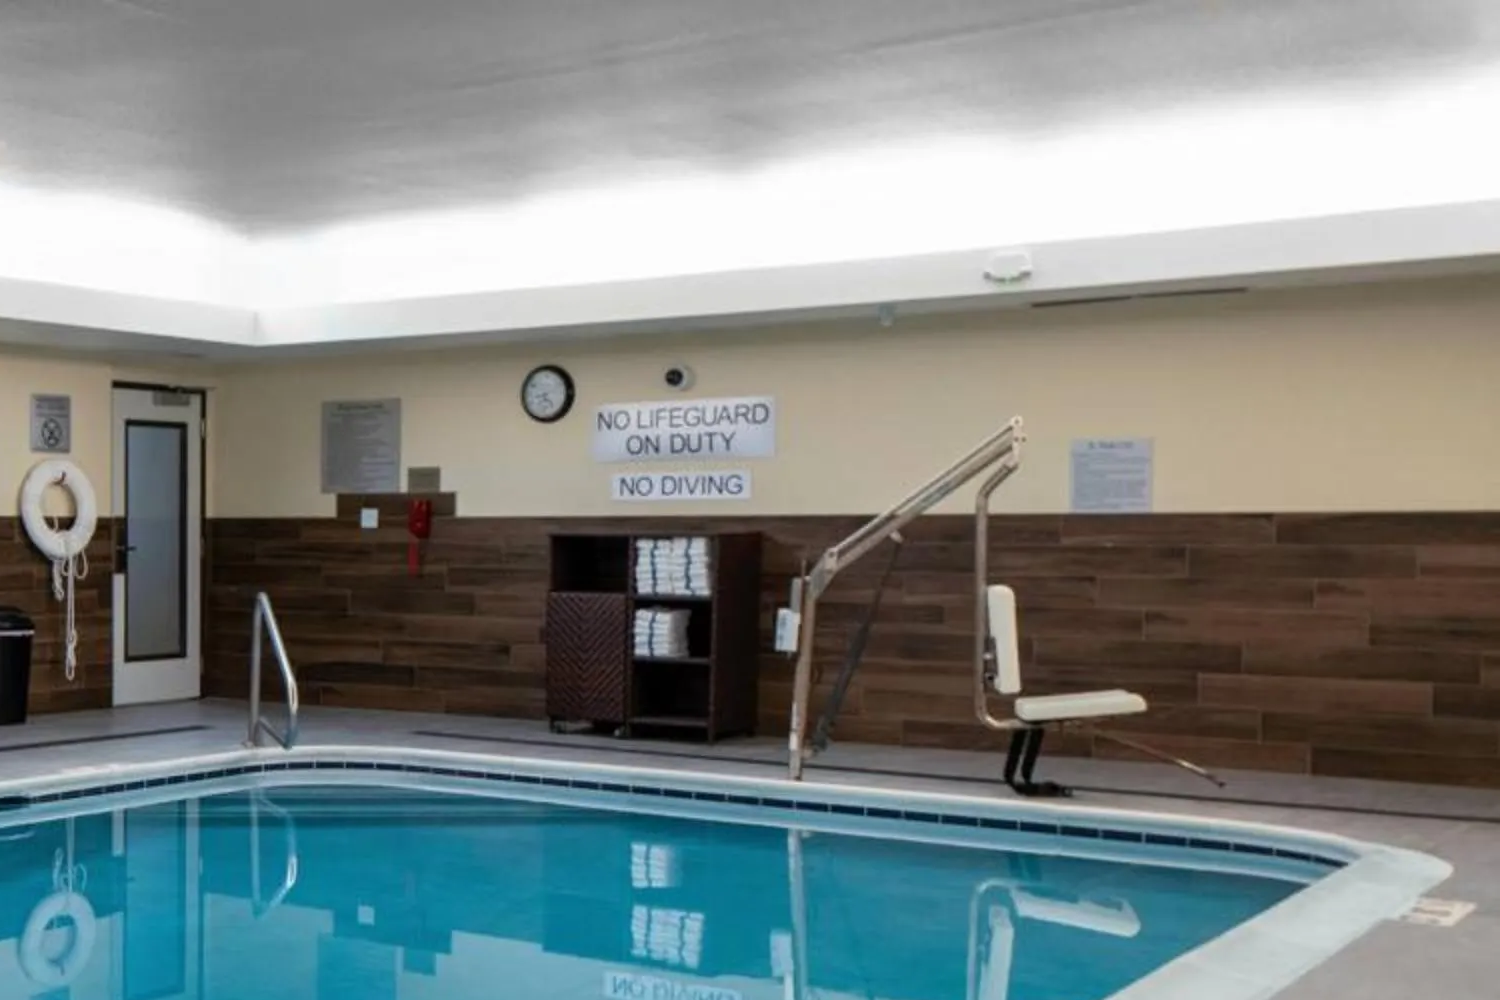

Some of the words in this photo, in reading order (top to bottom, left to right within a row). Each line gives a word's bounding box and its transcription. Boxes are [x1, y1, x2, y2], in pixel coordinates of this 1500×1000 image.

[596, 410, 631, 431] NO
[637, 403, 769, 429] LIFEGUARD
[626, 434, 660, 455] ON
[669, 431, 736, 454] DUTY
[619, 476, 653, 496] NO
[661, 473, 744, 496] DIVING
